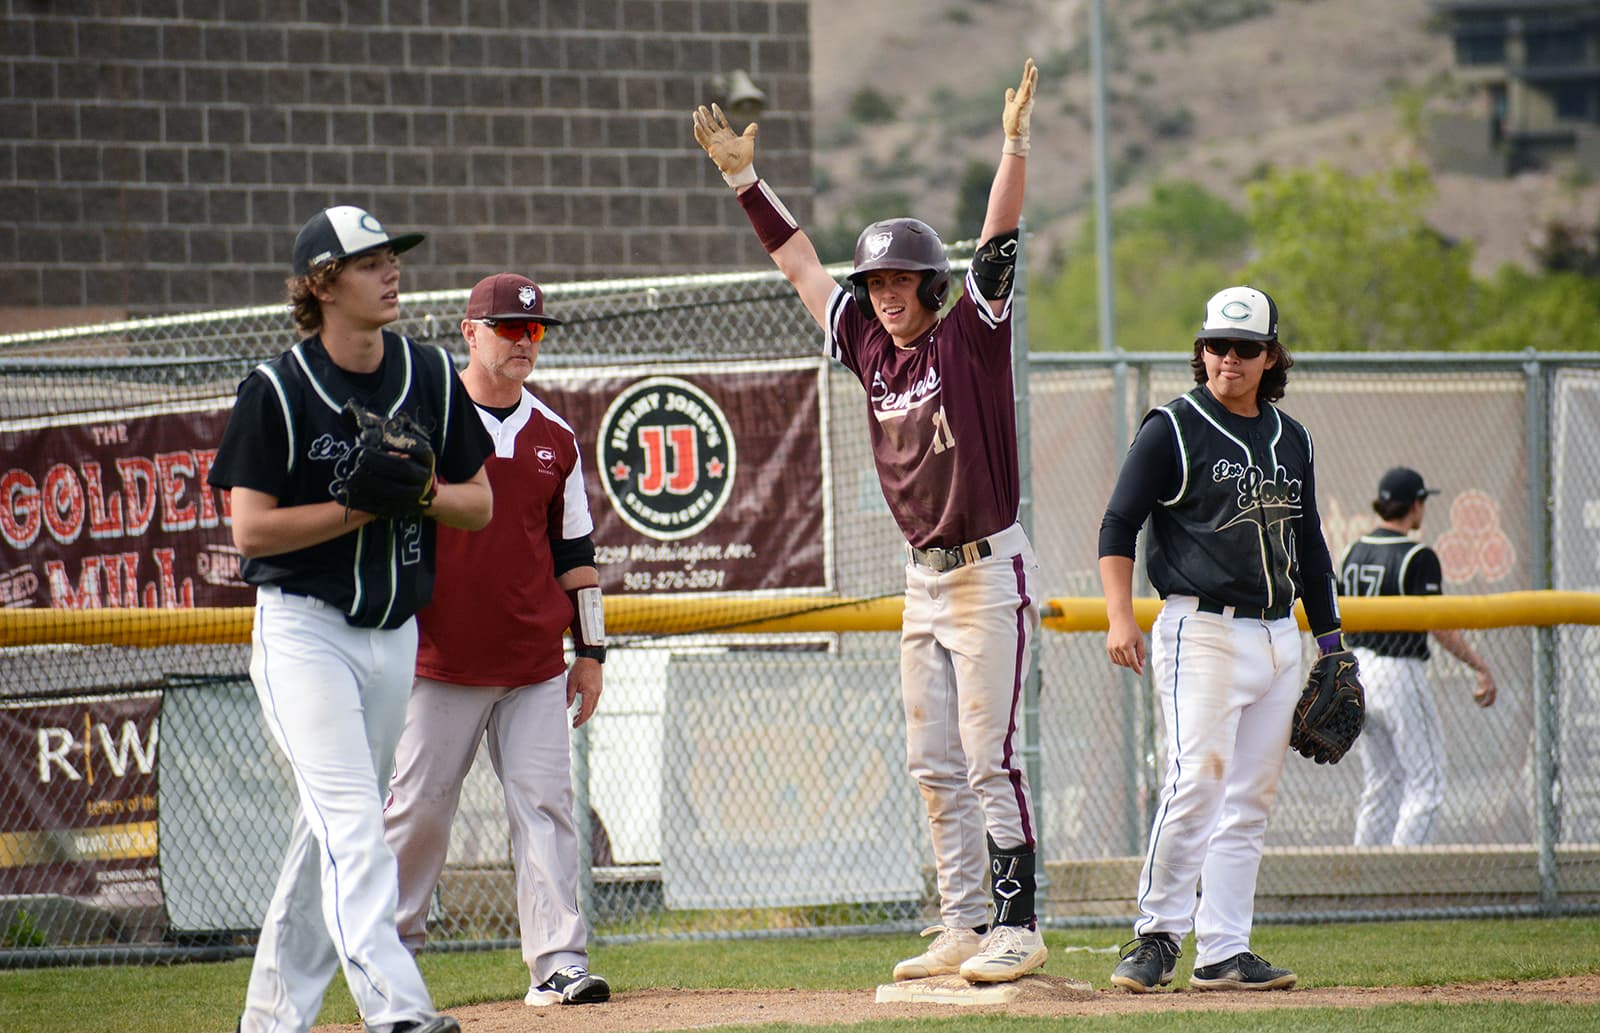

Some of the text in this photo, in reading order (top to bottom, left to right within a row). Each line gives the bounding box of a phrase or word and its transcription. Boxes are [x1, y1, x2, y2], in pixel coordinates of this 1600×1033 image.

[1220, 301, 1251, 322] C
[91, 425, 129, 446] THE
[611, 391, 722, 452] JIMMY JOHN'S
[931, 405, 956, 455] 11
[308, 433, 350, 460] Los
[637, 424, 699, 496] JJ
[1212, 459, 1303, 510] Los Lobo
[626, 489, 714, 526] SANDWICHES
[196, 553, 241, 578] DRIN
[724, 543, 757, 560] Ave.
[0, 573, 39, 603] EED
[45, 547, 195, 608] MILL
